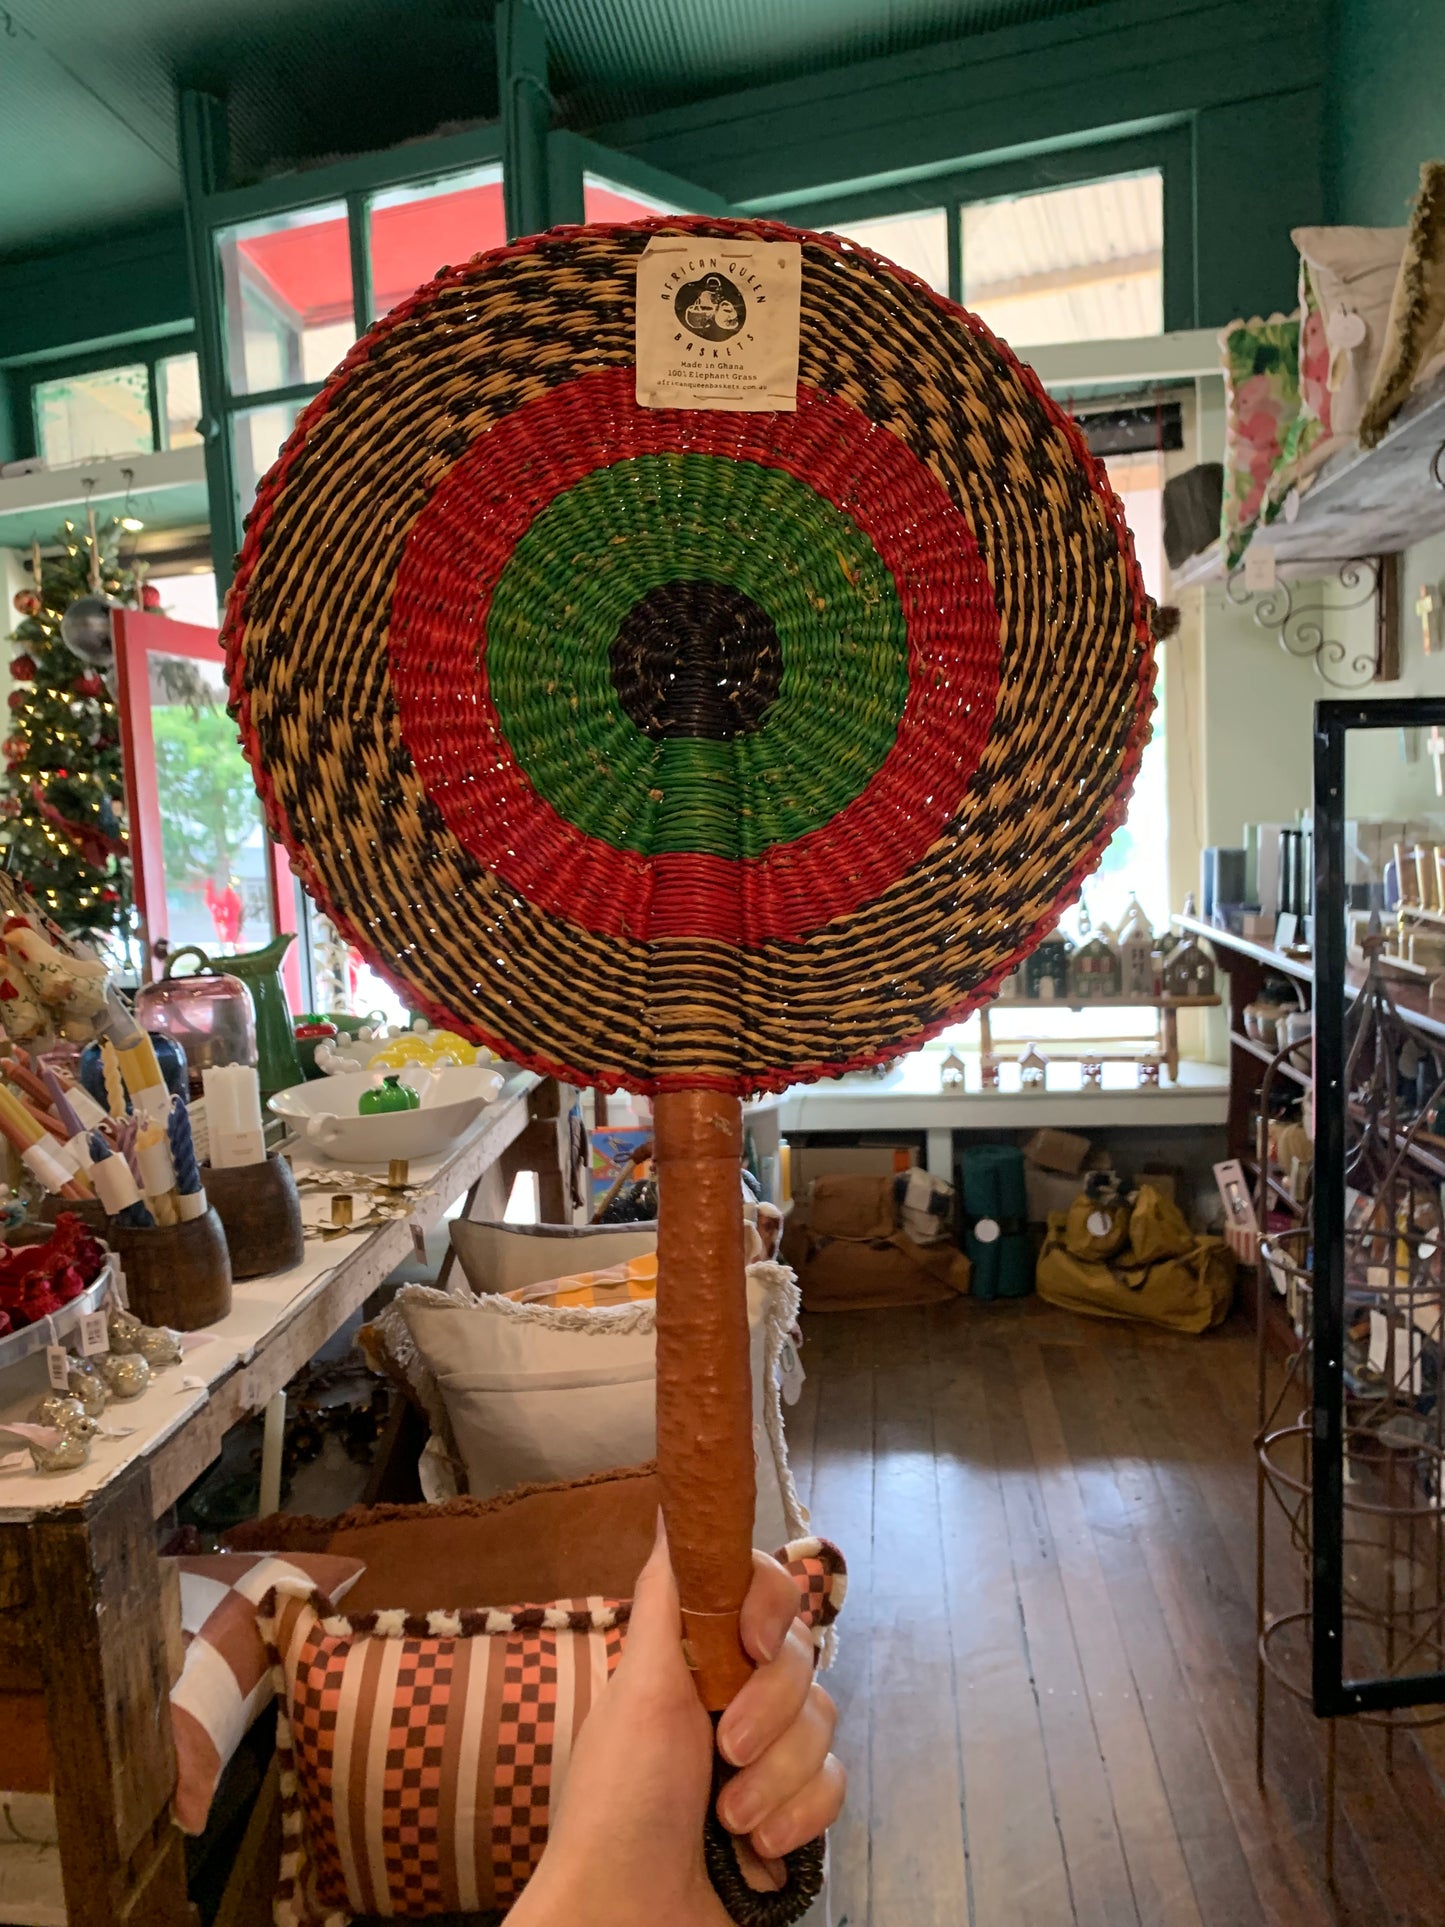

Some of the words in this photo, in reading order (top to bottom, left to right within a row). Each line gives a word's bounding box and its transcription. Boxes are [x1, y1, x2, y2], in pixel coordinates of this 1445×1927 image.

[661, 259, 716, 301] AFRICAN
[729, 263, 766, 304] QUEEN
[674, 333, 754, 358] BASKETS
[718, 362, 744, 370] Ghana
[689, 371, 730, 380] Elephant
